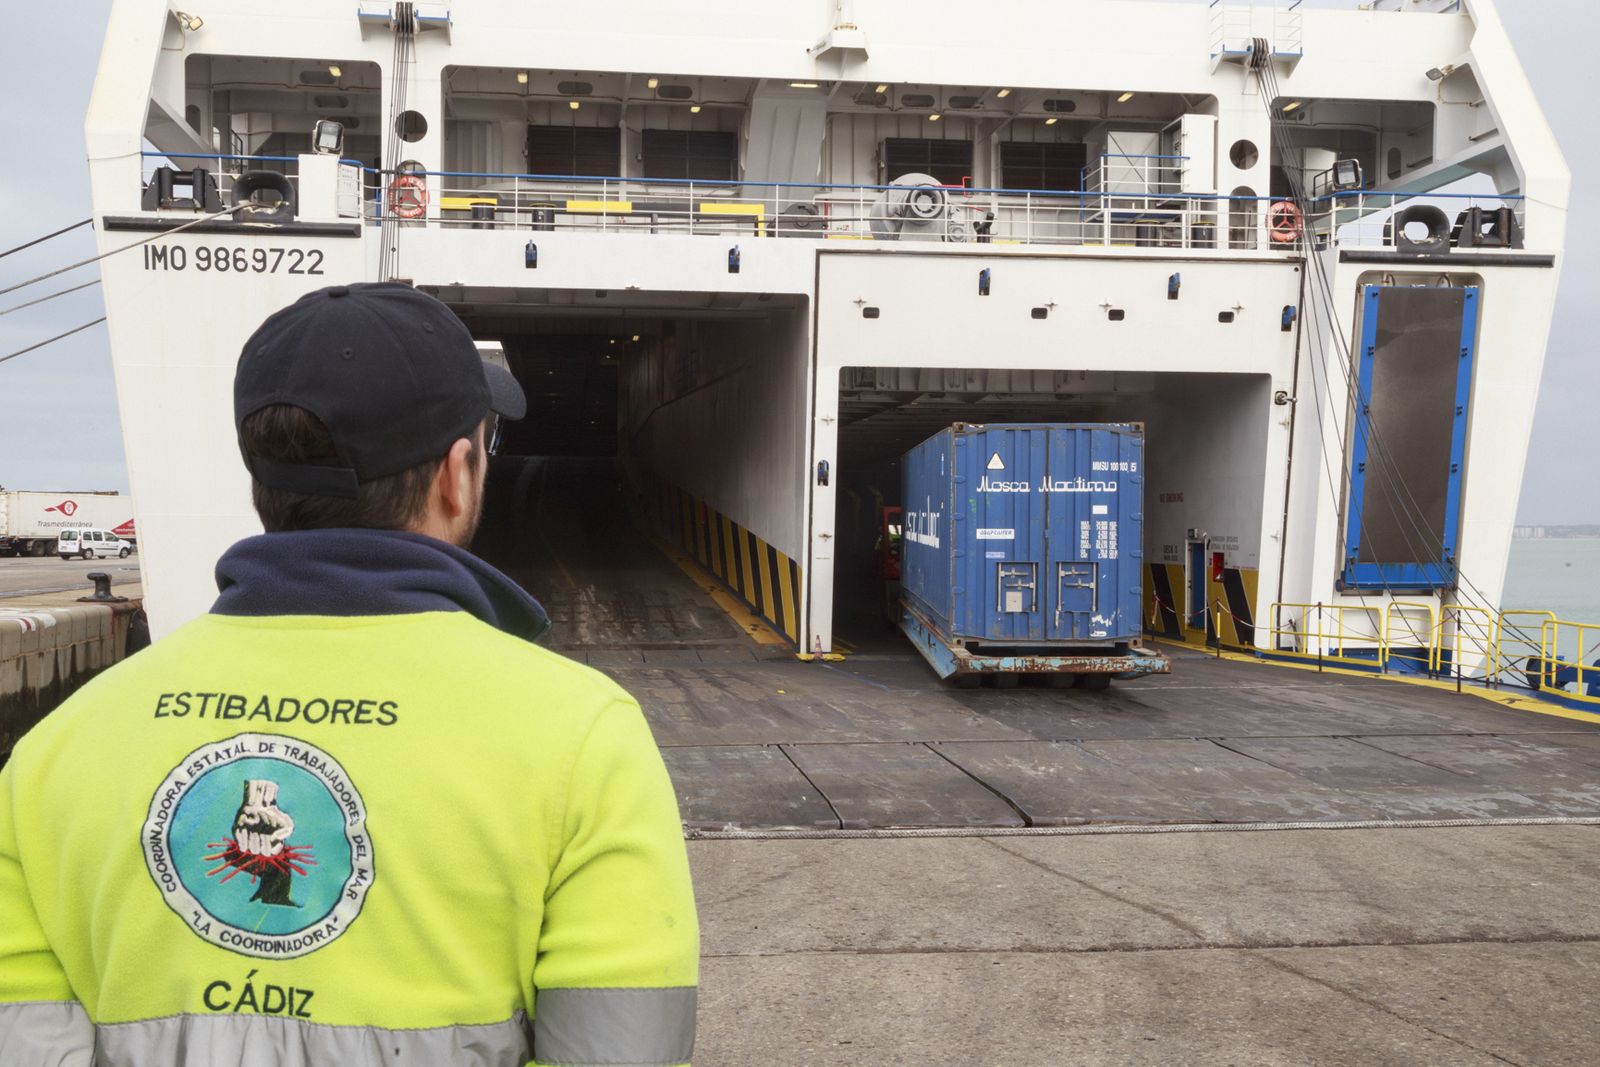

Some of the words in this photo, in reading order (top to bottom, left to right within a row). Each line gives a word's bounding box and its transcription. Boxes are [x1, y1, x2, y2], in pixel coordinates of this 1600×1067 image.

[144, 244, 187, 271] IMO
[195, 246, 324, 275] 9869722
[976, 475, 1031, 492] Mosca
[154, 692, 399, 726] ESTIBADORES
[186, 742, 250, 779] ESTATAL
[258, 742, 276, 753] DE
[284, 744, 360, 827] TRABAJADORES
[149, 780, 187, 893] COORDINADORA
[352, 834, 367, 861] DEL
[346, 868, 368, 901] MAR
[203, 968, 315, 1018] CÁDIZ
